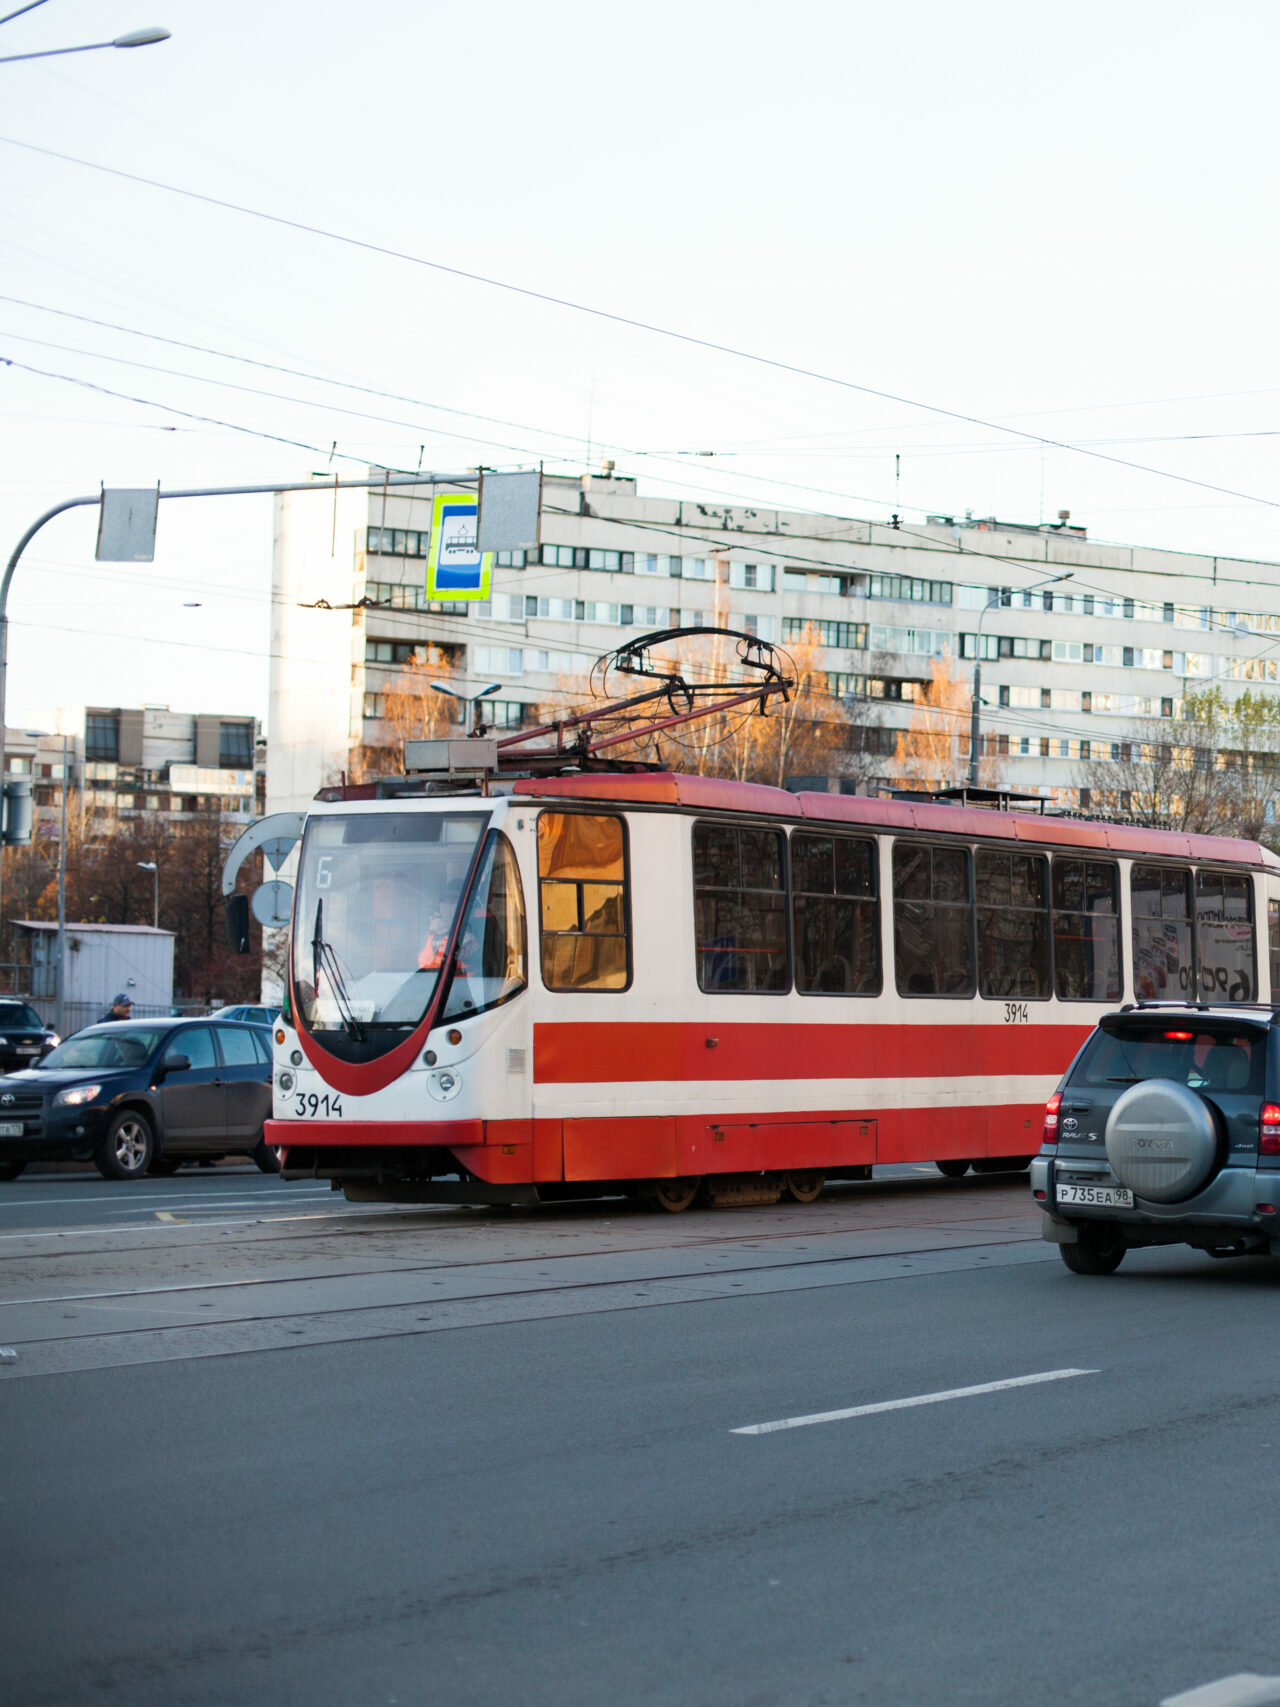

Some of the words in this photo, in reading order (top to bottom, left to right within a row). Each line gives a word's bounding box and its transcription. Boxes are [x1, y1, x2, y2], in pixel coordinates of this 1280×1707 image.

[315, 856, 333, 888] 6
[1005, 1003, 1028, 1023] 3914
[295, 1093, 342, 1117] 3914
[1115, 1188, 1128, 1201] 98
